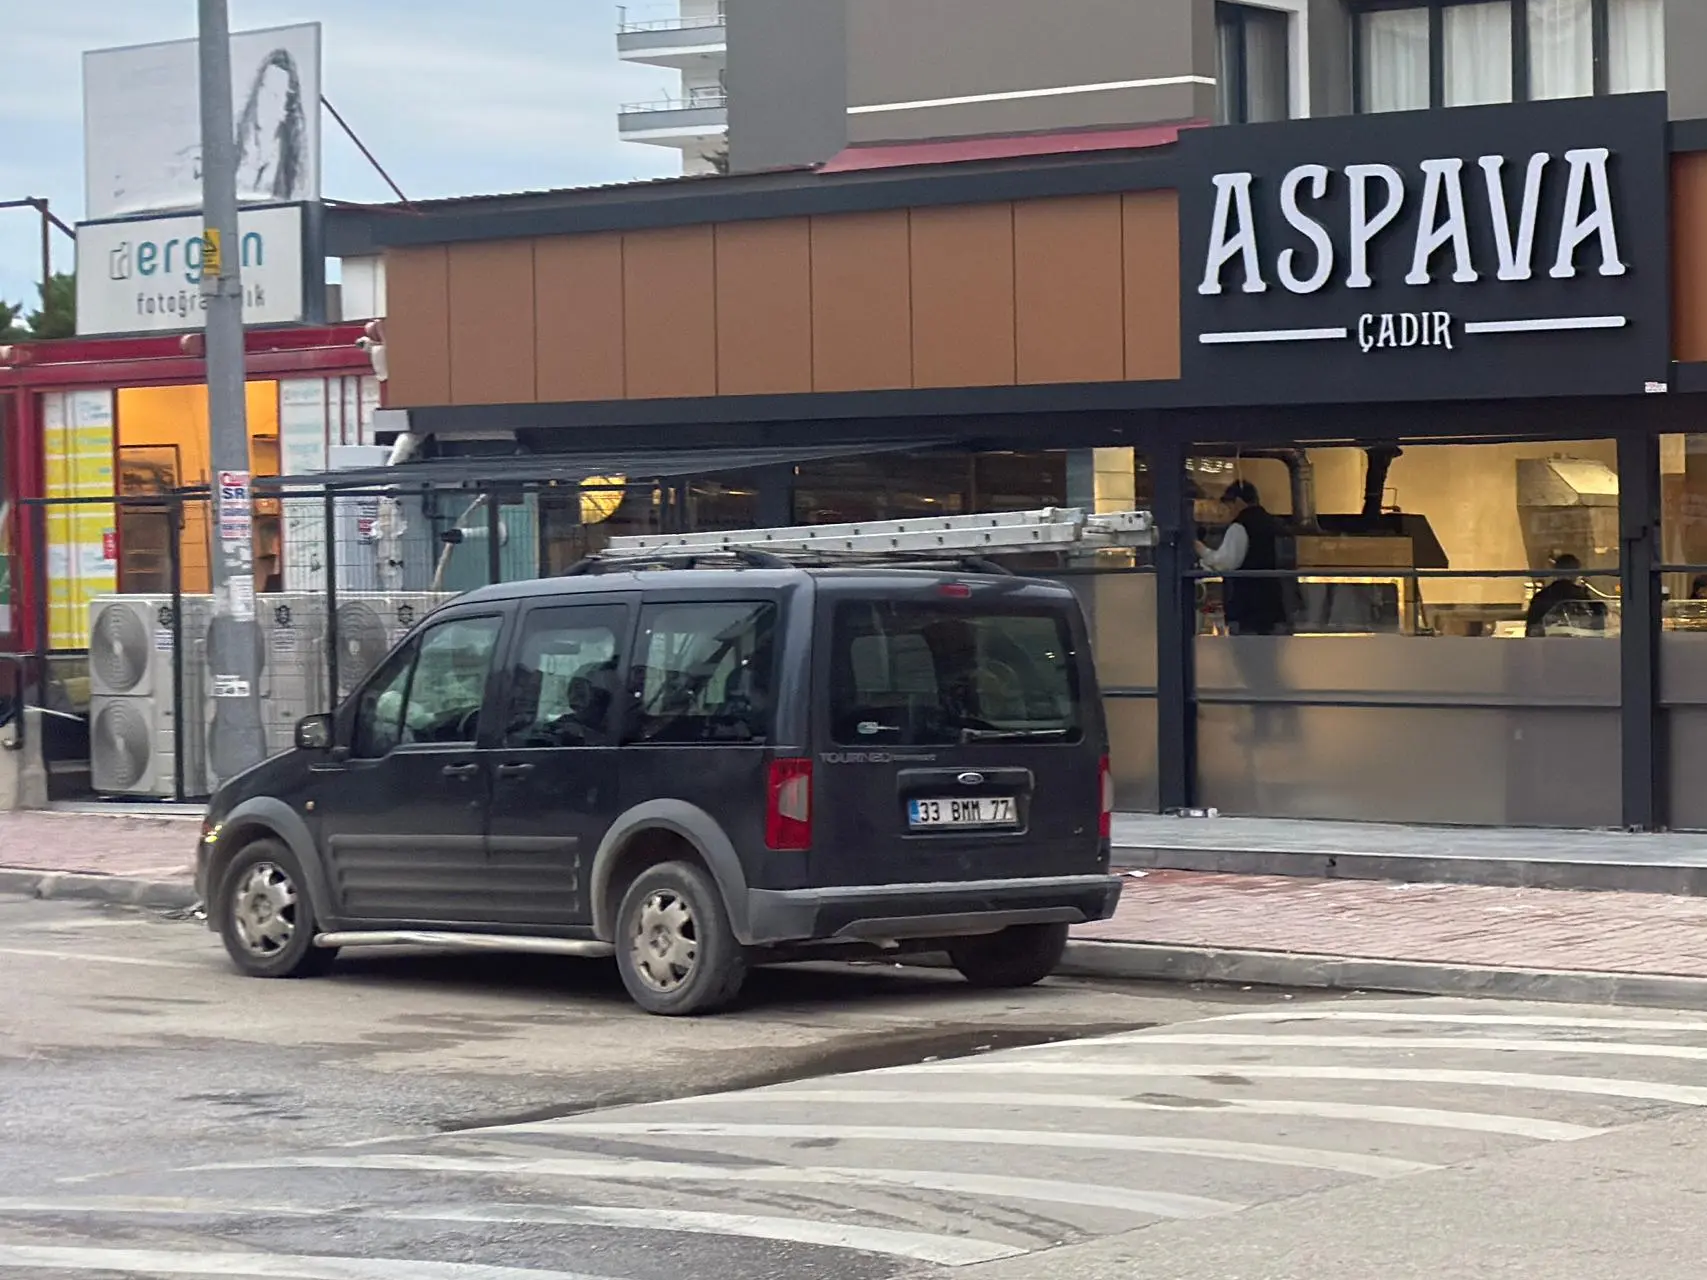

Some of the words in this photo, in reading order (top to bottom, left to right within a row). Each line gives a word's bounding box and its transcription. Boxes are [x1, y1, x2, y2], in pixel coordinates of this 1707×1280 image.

[1198, 148, 1626, 294] ASPAVA
[137, 232, 264, 284] ergn
[1358, 311, 1454, 352] ÇADIR
[920, 801, 940, 821] 33
[951, 801, 980, 821] BMM
[990, 800, 1009, 820] 77
